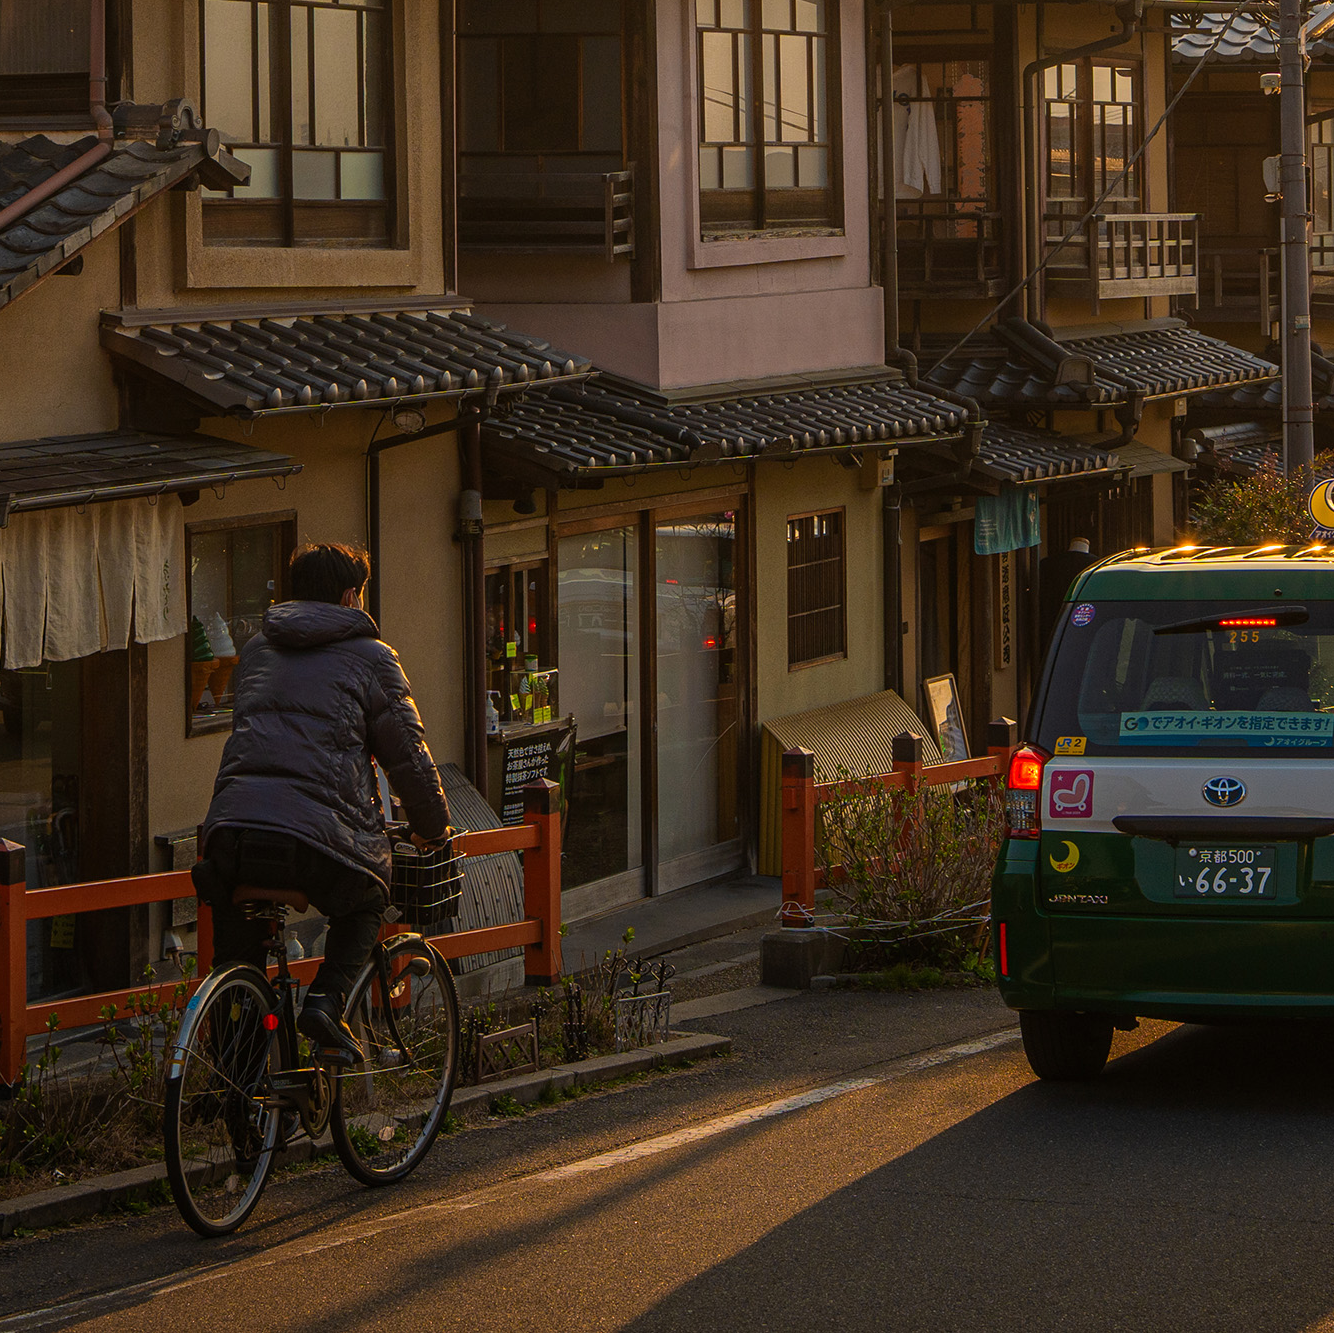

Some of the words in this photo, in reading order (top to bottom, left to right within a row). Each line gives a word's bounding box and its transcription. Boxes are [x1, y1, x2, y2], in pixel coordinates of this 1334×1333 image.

[1229, 631, 1260, 643] 255
[1057, 738, 1072, 747] JR
[1074, 738, 1082, 747] 2
[1276, 738, 1327, 746] アオイグループ
[1199, 849, 1254, 864] 京都500
[1195, 867, 1272, 894] 66-37
